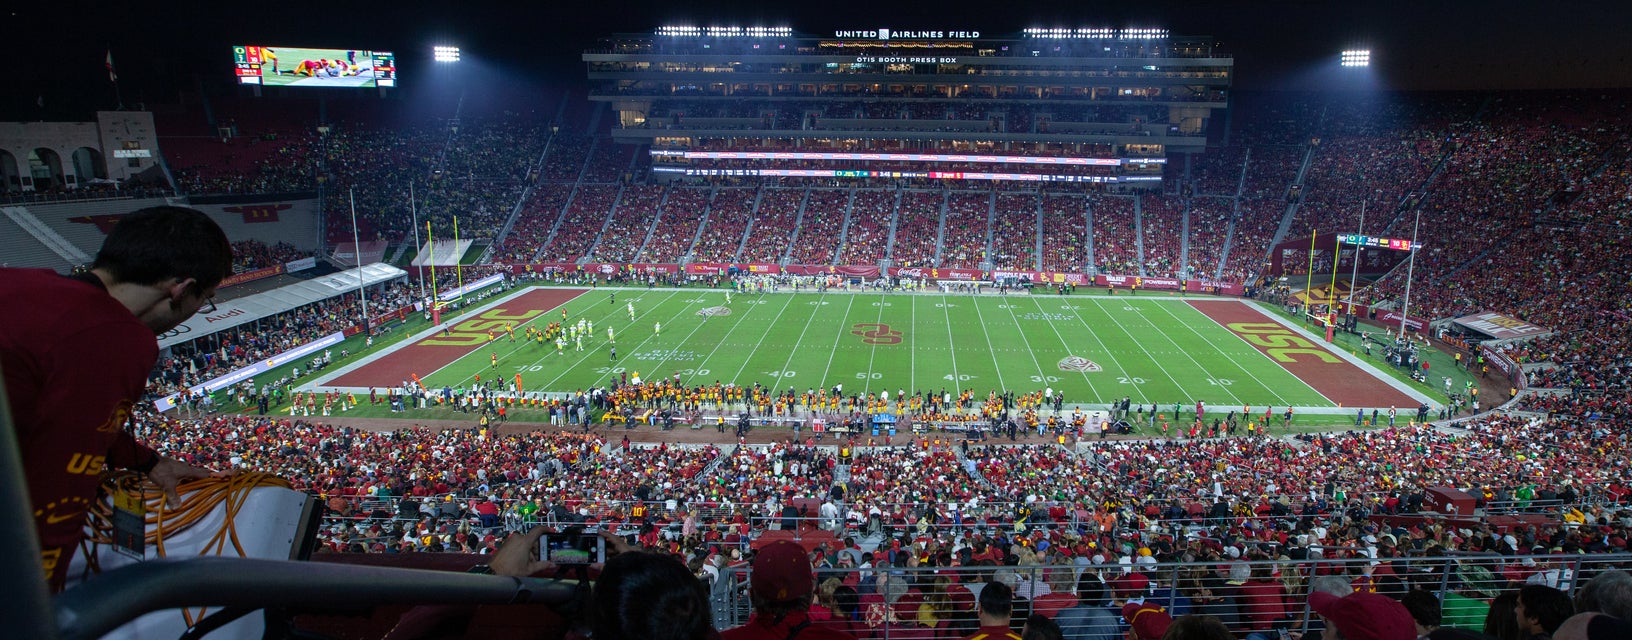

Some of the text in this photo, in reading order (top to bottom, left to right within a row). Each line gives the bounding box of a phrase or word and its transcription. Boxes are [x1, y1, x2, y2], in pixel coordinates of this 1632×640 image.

[835, 30, 877, 38] UNITED
[205, 309, 245, 323] Audi
[417, 309, 545, 346] USC
[1226, 322, 1344, 363] USC
[768, 370, 796, 378] 40
[855, 372, 883, 380] 50
[1030, 375, 1058, 383] 30
[1206, 378, 1232, 386] 10
[633, 507, 642, 517] 10
